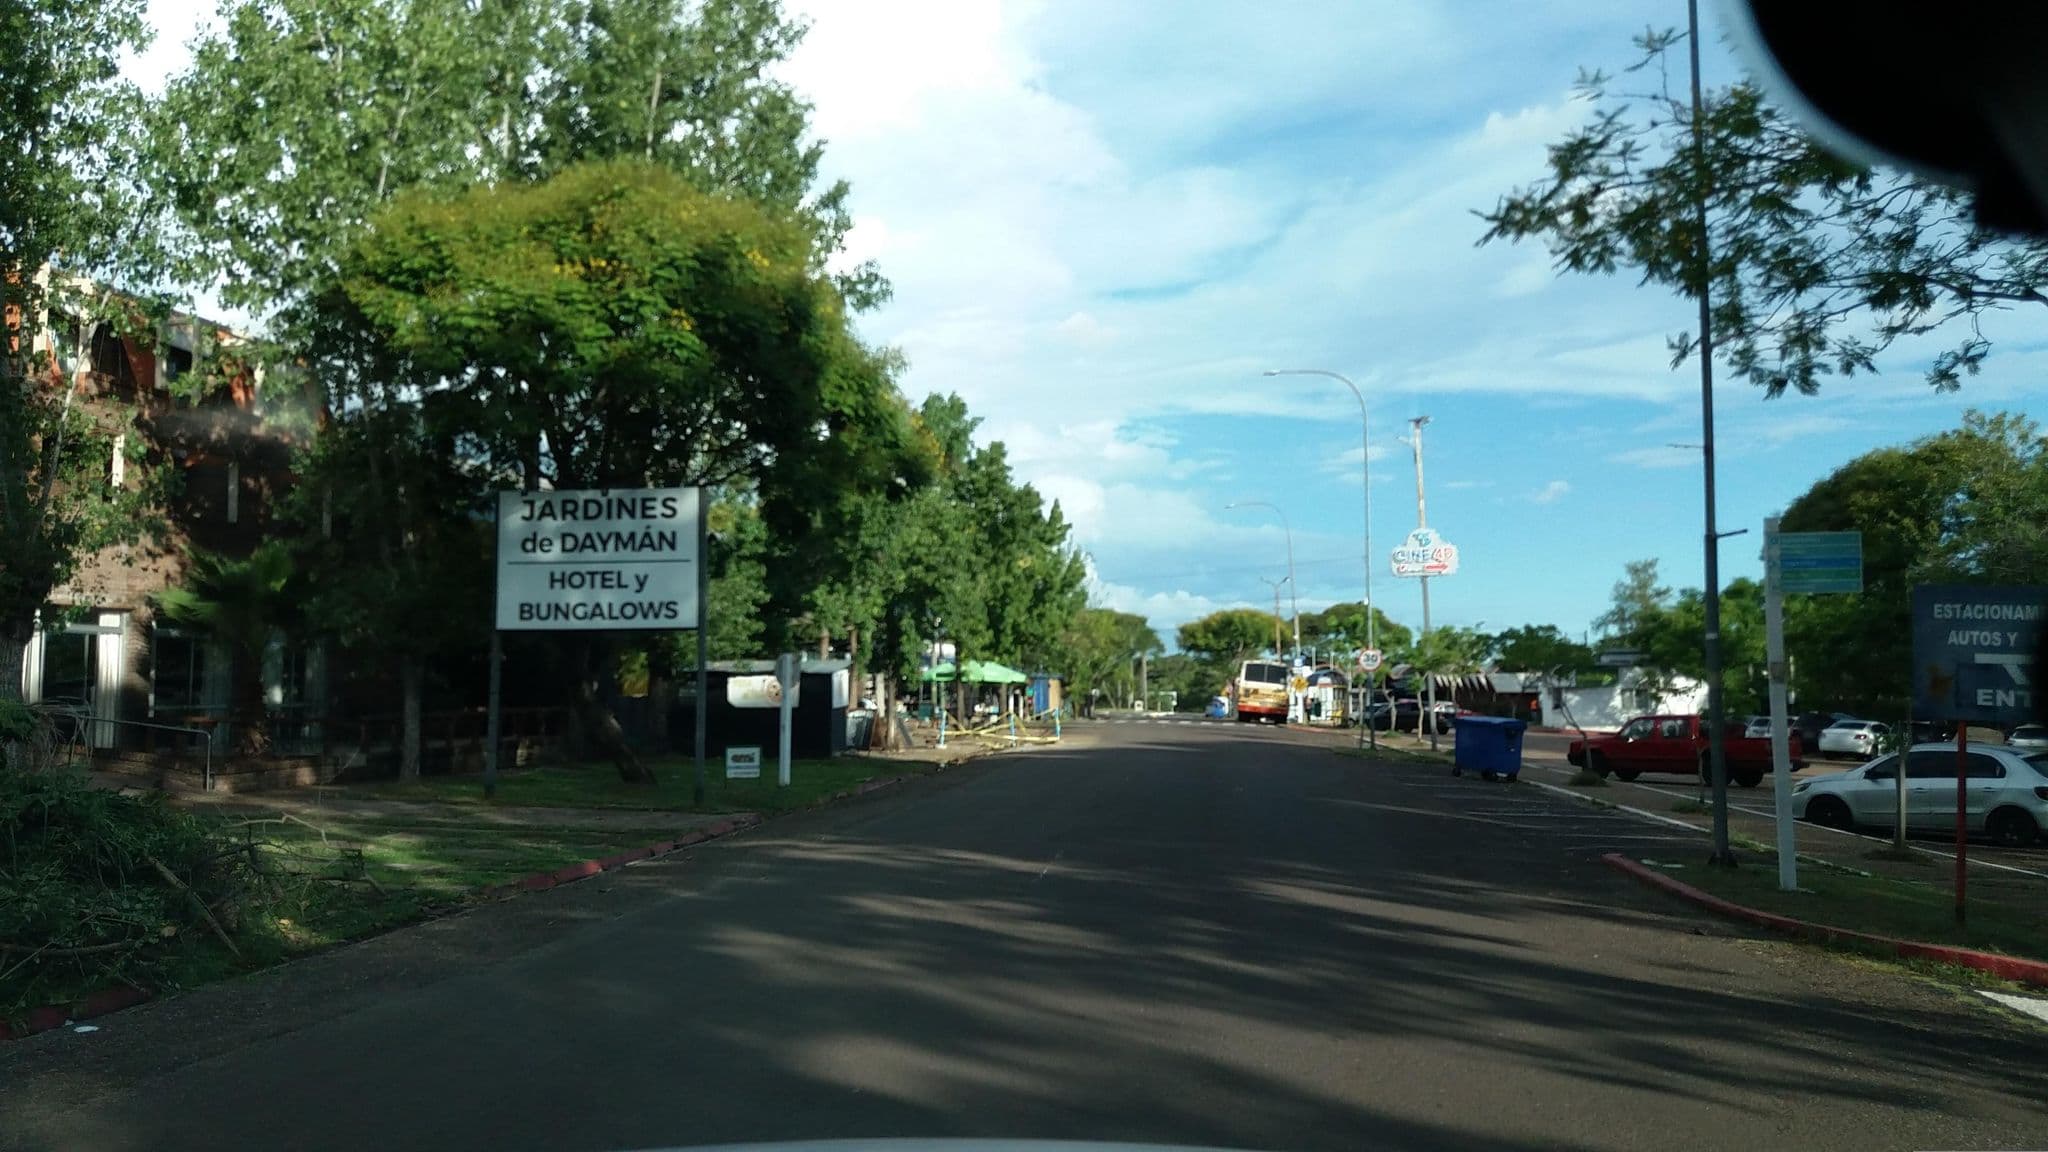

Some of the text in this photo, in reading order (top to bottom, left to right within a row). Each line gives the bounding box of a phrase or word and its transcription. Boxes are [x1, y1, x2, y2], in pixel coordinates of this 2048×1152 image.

[521, 496, 678, 521] JARDINES
[520, 525, 677, 553] de DAYMÁN
[549, 571, 648, 593] HOTEL y
[518, 600, 679, 621] BUNGALOWS
[1947, 630, 2019, 646] AUTOS Y
